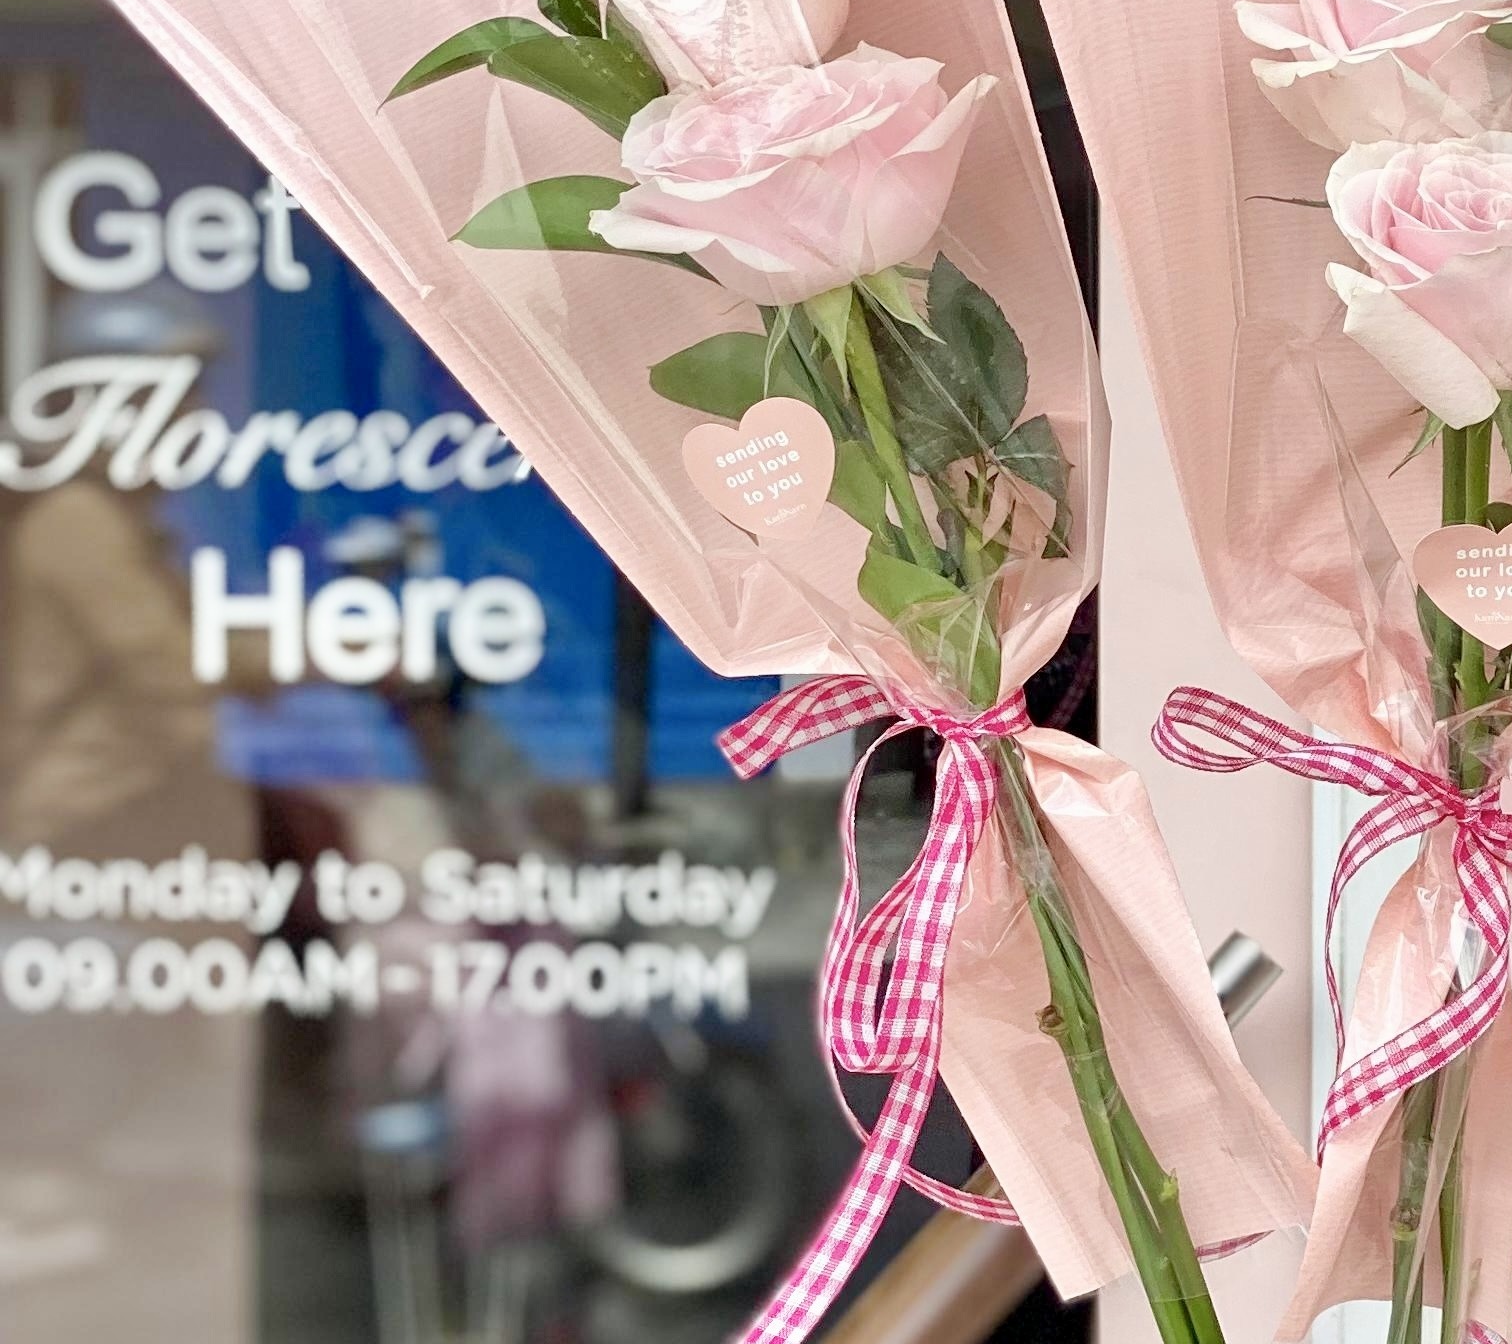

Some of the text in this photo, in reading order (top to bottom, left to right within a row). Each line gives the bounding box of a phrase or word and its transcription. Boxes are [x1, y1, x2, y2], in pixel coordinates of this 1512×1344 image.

[34, 150, 311, 292] Get
[716, 430, 790, 468] sending
[726, 450, 800, 488] our love
[743, 471, 803, 506] to you
[1455, 566, 1491, 578] our
[1466, 584, 1487, 598] to
[191, 546, 546, 685] Here
[313, 849, 406, 924] to
[419, 848, 777, 939] Saturday
